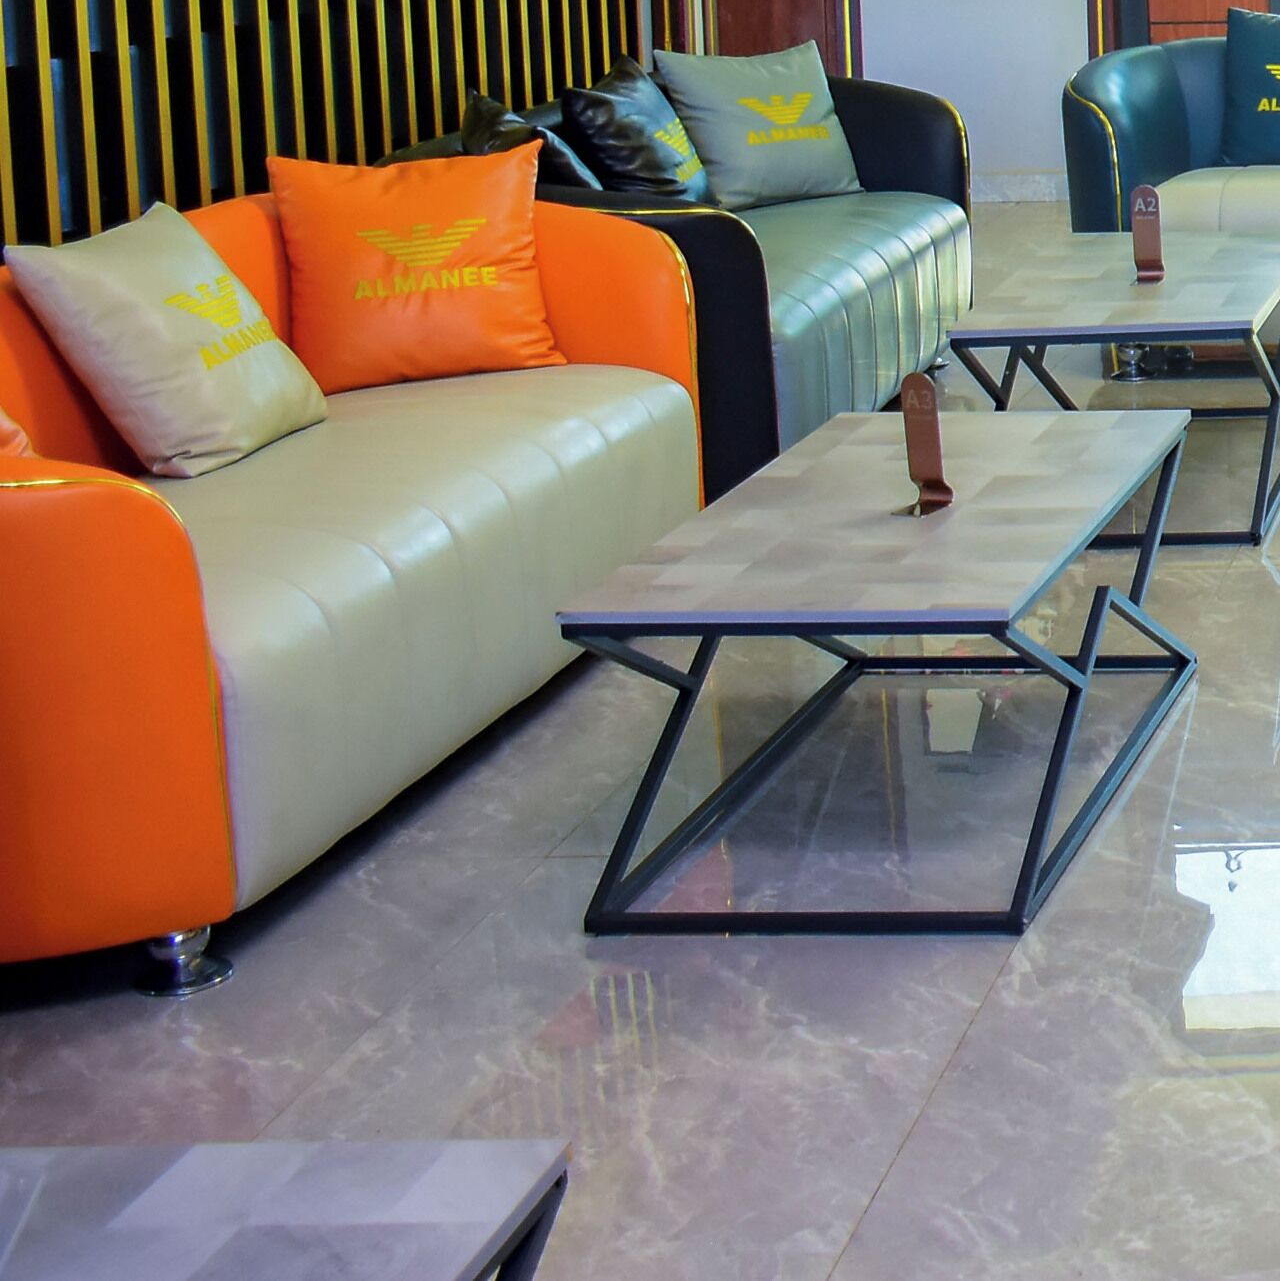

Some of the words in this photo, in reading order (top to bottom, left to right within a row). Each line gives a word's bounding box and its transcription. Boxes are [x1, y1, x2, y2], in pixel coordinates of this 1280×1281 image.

[747, 126, 830, 146] ALMANEE
[1134, 197, 1157, 212] A2
[354, 266, 498, 300] ALMANEE
[199, 320, 276, 371] ALMANE
